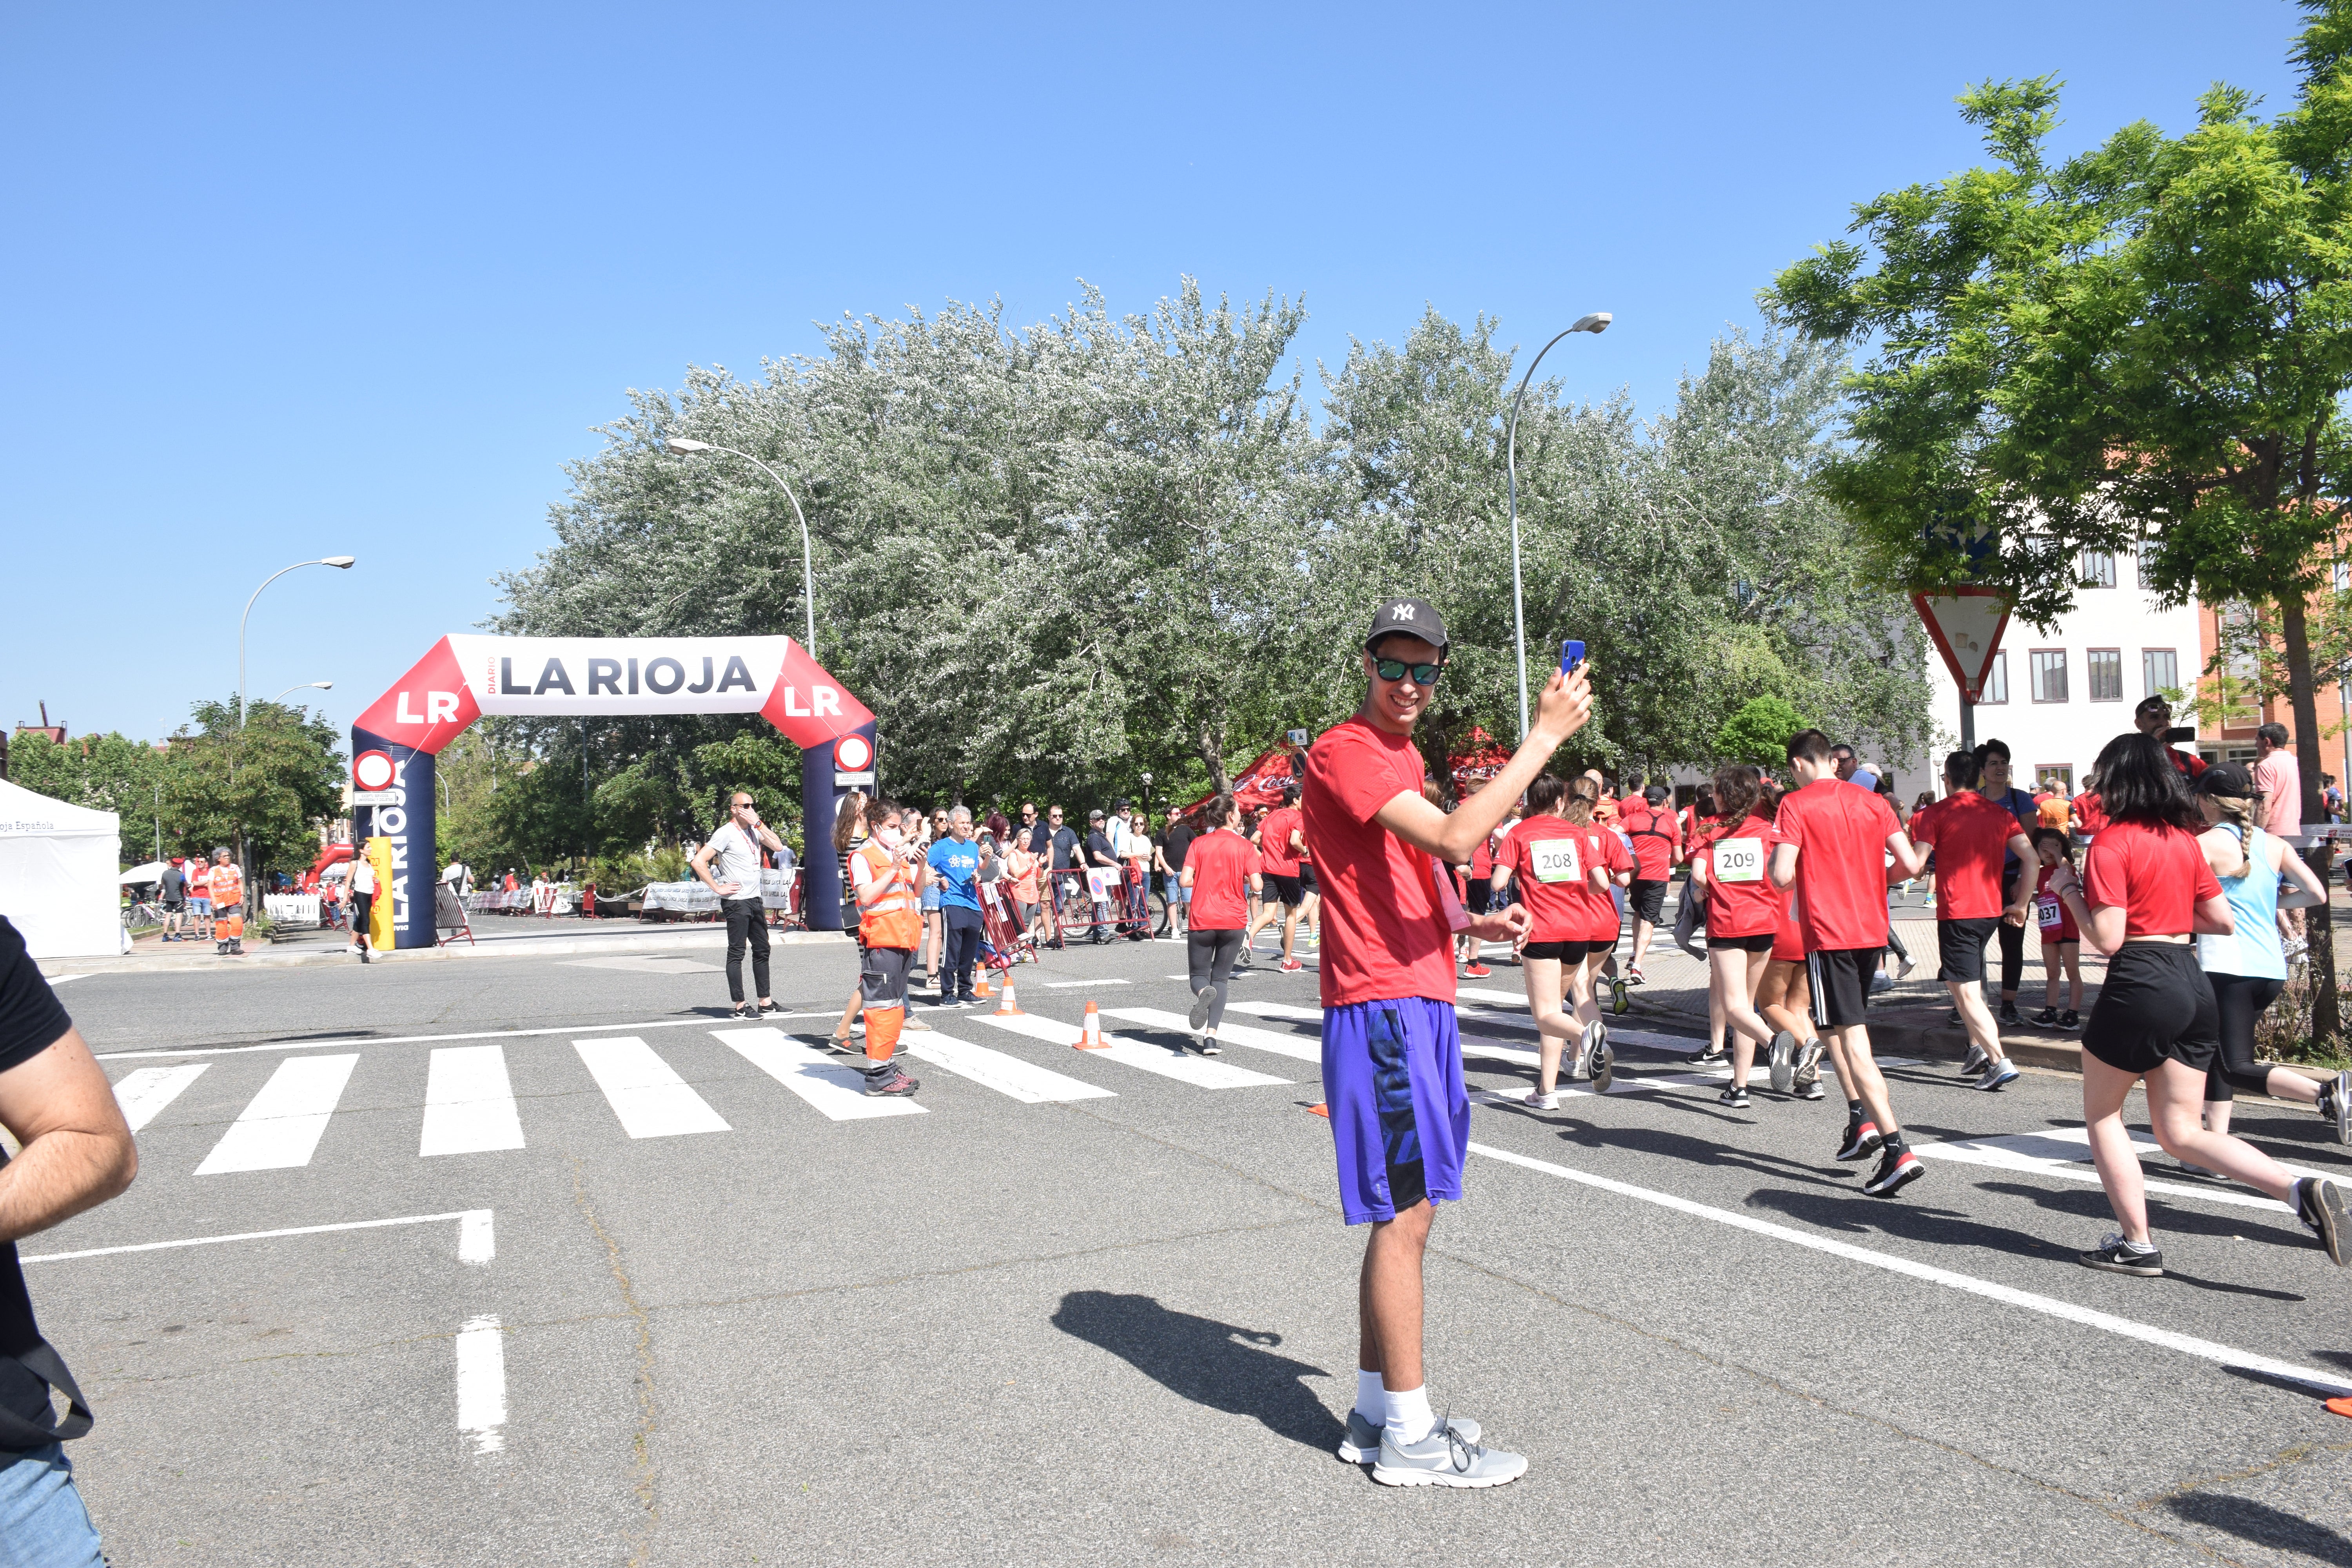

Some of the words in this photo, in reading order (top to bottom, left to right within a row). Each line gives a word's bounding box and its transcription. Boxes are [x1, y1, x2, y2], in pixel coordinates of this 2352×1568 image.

[488, 657, 496, 694] DIARIO
[501, 657, 576, 695] LA
[588, 656, 757, 695] RIOJA
[396, 691, 459, 724] LR
[784, 685, 843, 717] LR
[16, 822, 54, 831] Española
[1542, 853, 1572, 869] 208
[1723, 853, 1755, 868] 209
